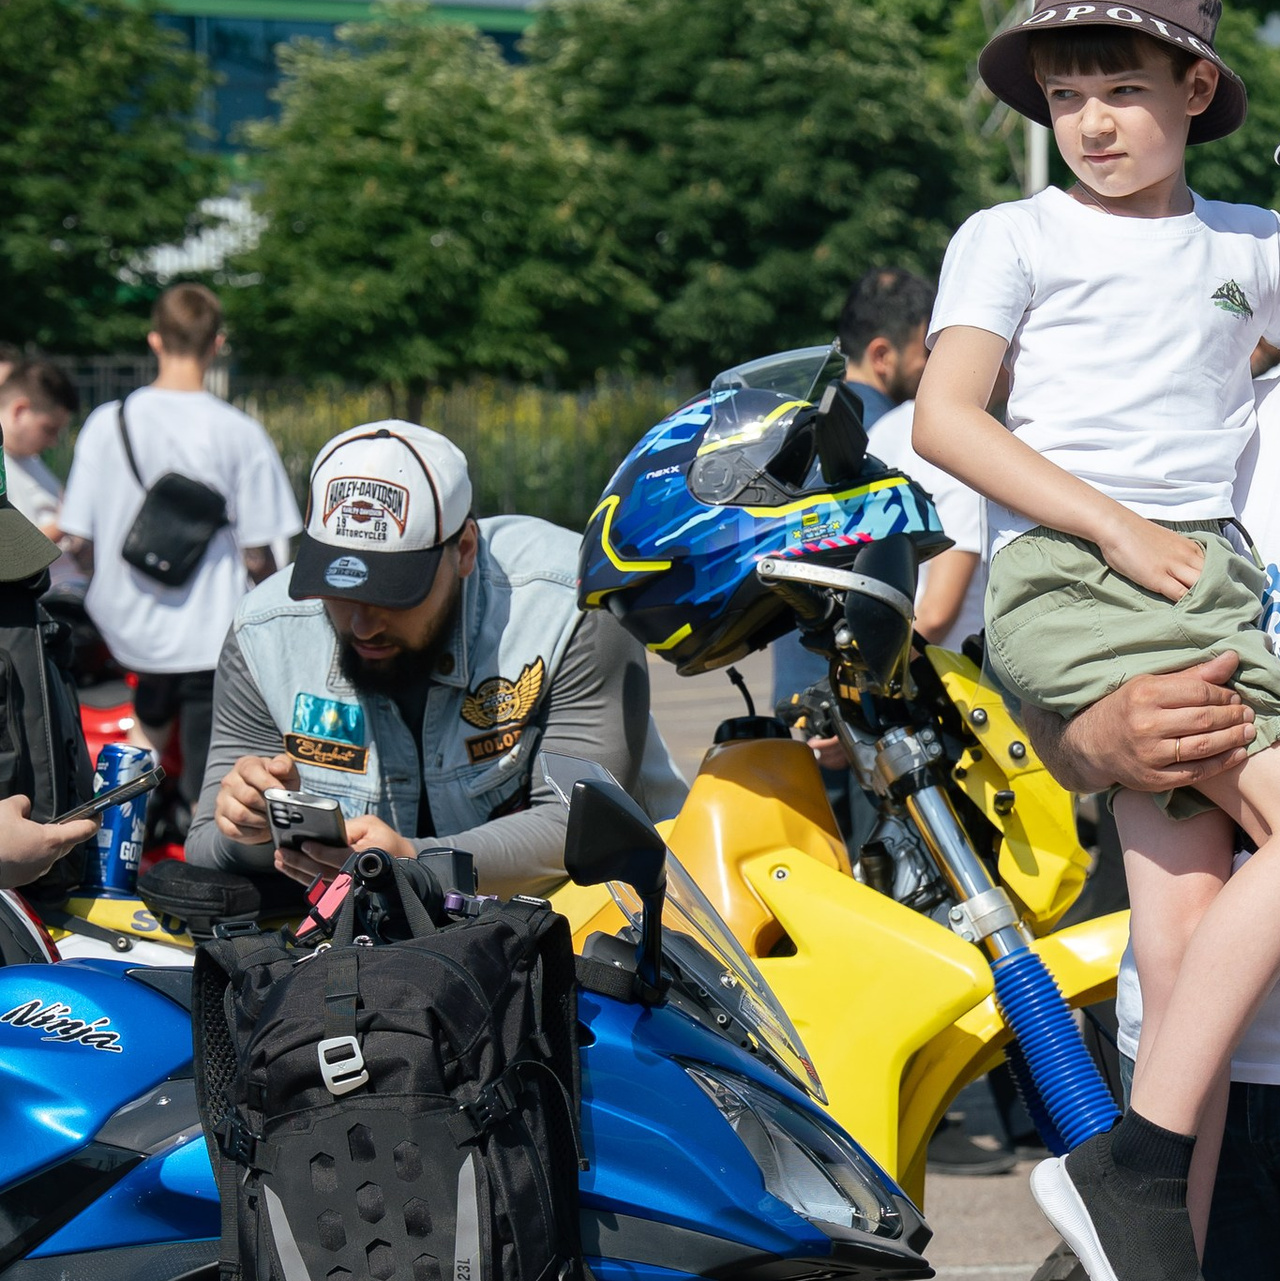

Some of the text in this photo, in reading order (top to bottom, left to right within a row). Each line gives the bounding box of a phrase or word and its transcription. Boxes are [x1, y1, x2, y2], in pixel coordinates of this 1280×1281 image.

[329, 481, 404, 519] HARLEY-DAVIDSON
[336, 517, 387, 532] 19 03
[336, 528, 387, 541] MOTORCYCLES
[1, 999, 122, 1053] Ninja
[457, 1258, 470, 1281] 23L
